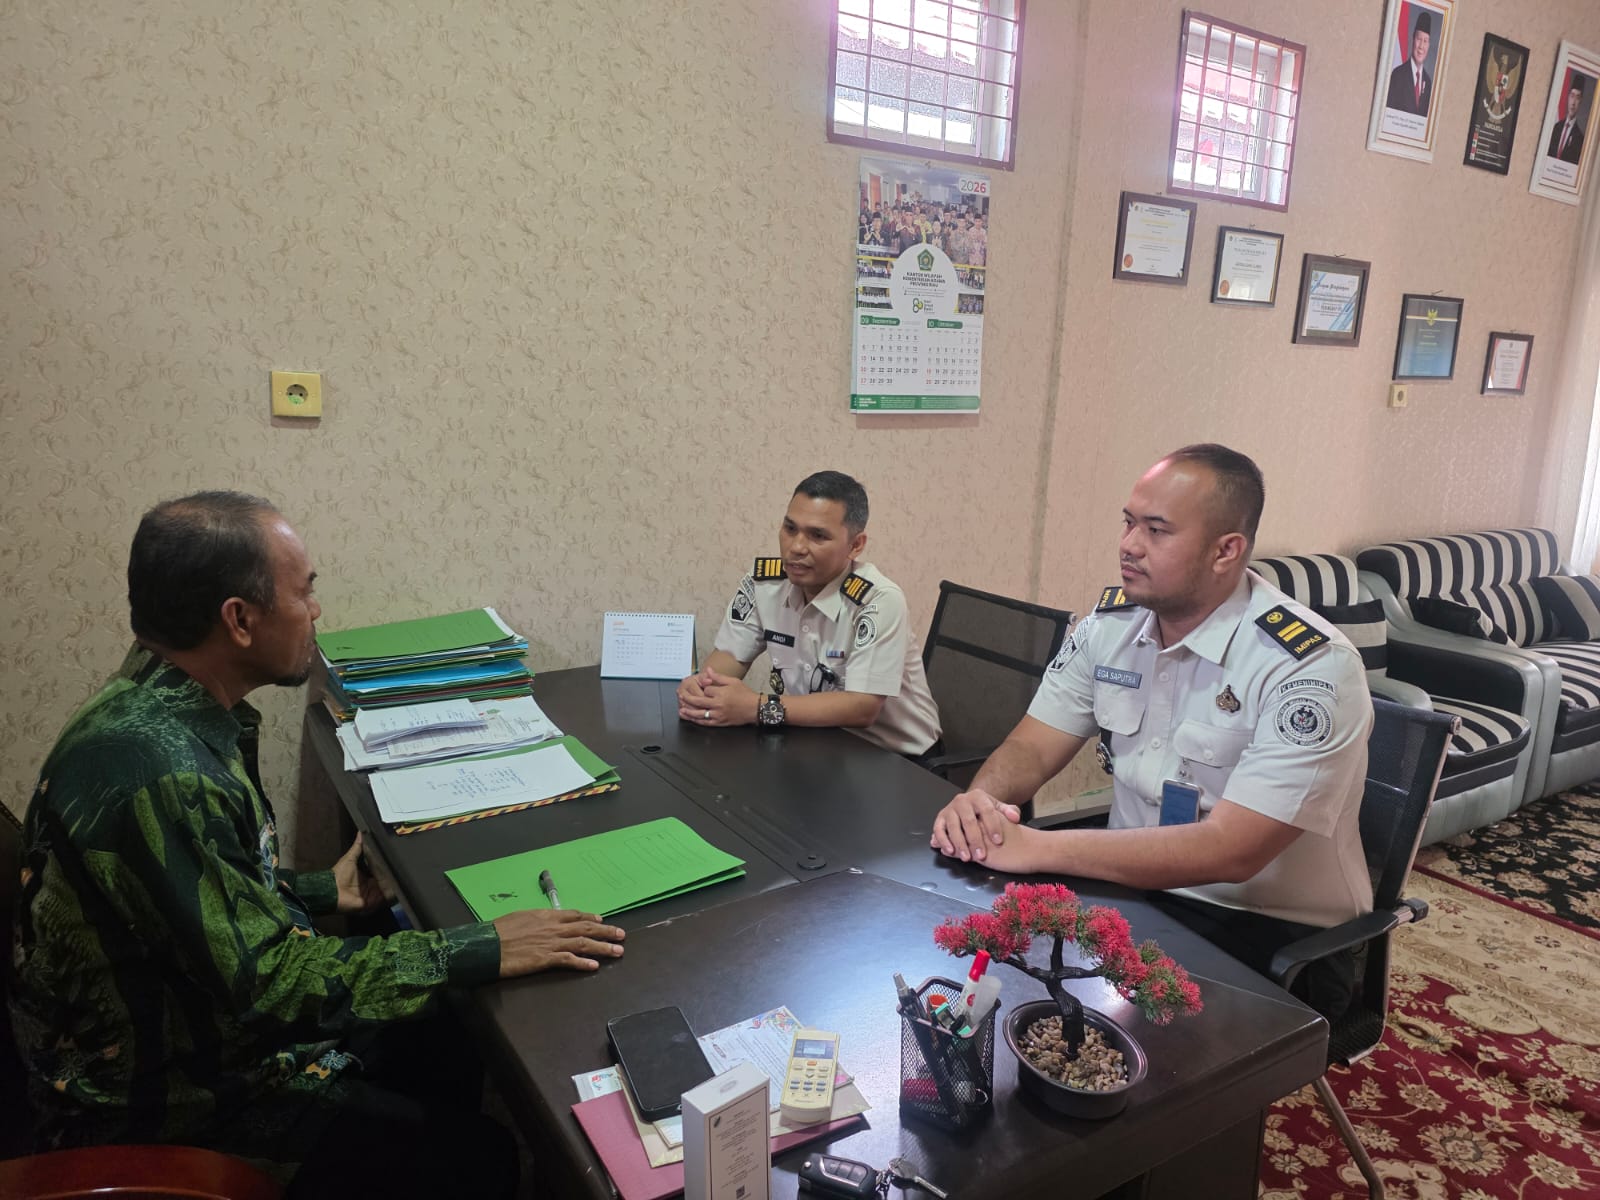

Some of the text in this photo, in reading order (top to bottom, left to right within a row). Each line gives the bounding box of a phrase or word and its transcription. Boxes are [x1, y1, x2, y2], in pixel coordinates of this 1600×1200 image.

[960, 179, 987, 194] 2026
[772, 634, 786, 643] ANDI
[1294, 634, 1322, 654] IMIPAS
[1097, 668, 1109, 679] EGA
